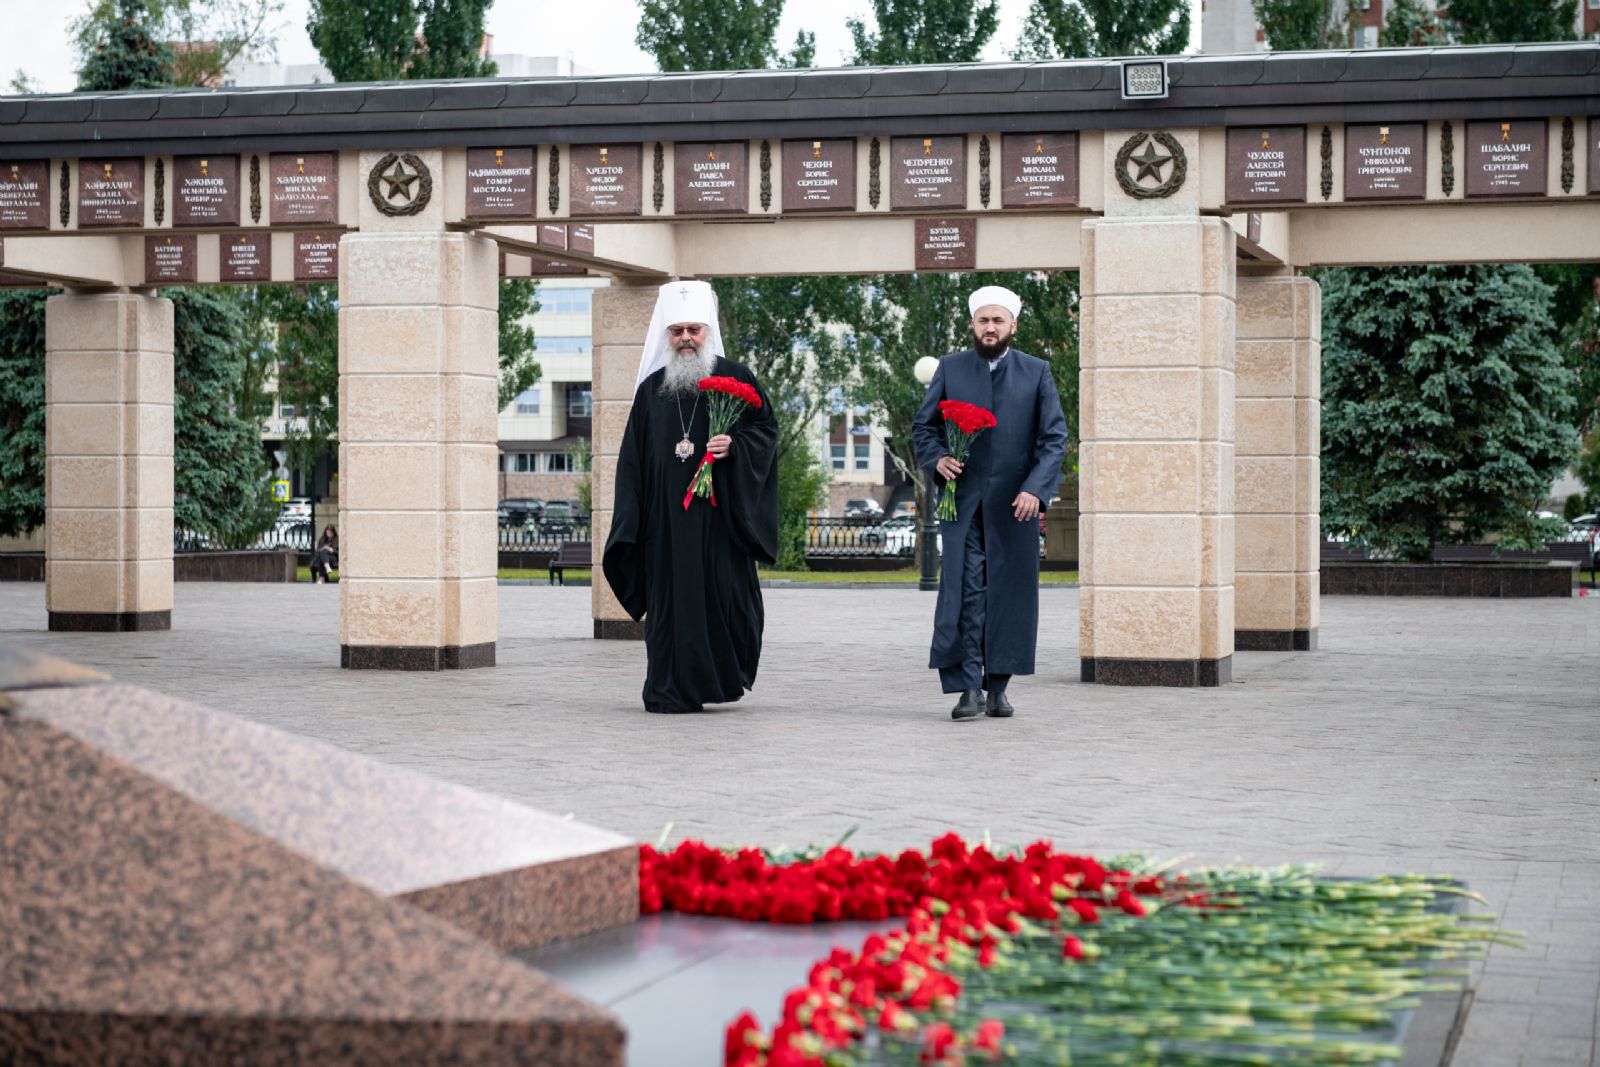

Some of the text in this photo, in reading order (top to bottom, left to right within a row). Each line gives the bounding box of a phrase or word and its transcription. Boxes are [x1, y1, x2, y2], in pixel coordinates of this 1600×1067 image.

[1359, 146, 1411, 156] ЧУНТОНОВ
[1481, 143, 1531, 153] ШАБАЛИН
[1247, 151, 1285, 160] ЧУЛКОВ
[1492, 154, 1520, 162] БОРИС
[802, 160, 833, 169] ЧЕКИН
[903, 158, 953, 167] ЧЕПУРЕНКО
[1021, 156, 1058, 165] ЧИРКОВ
[1247, 160, 1285, 170] АЛЕКСЕЙ
[1364, 156, 1405, 165] НИКОЛАЙ
[585, 166, 624, 175] ХРЕБТОВ
[693, 162, 730, 172] ЦАПЛИН
[907, 166, 949, 175] АНАТОЛИЙ
[1358, 166, 1412, 175] ГРИГОРЬЕВИЧ
[1483, 163, 1529, 171] СЕРГЕЕВИЧ
[805, 170, 830, 178] БОРИС
[1015, 174, 1065, 183] АЛЕКСЕЕВИЧ
[1244, 170, 1286, 178] ПЕТРОВИЧ
[688, 180, 736, 188] АЛЕКСЕЕВИЧ
[797, 178, 838, 187] СЕРГЕЕВИЧ
[903, 176, 952, 185] АЛЕКСЕЕВИЧ
